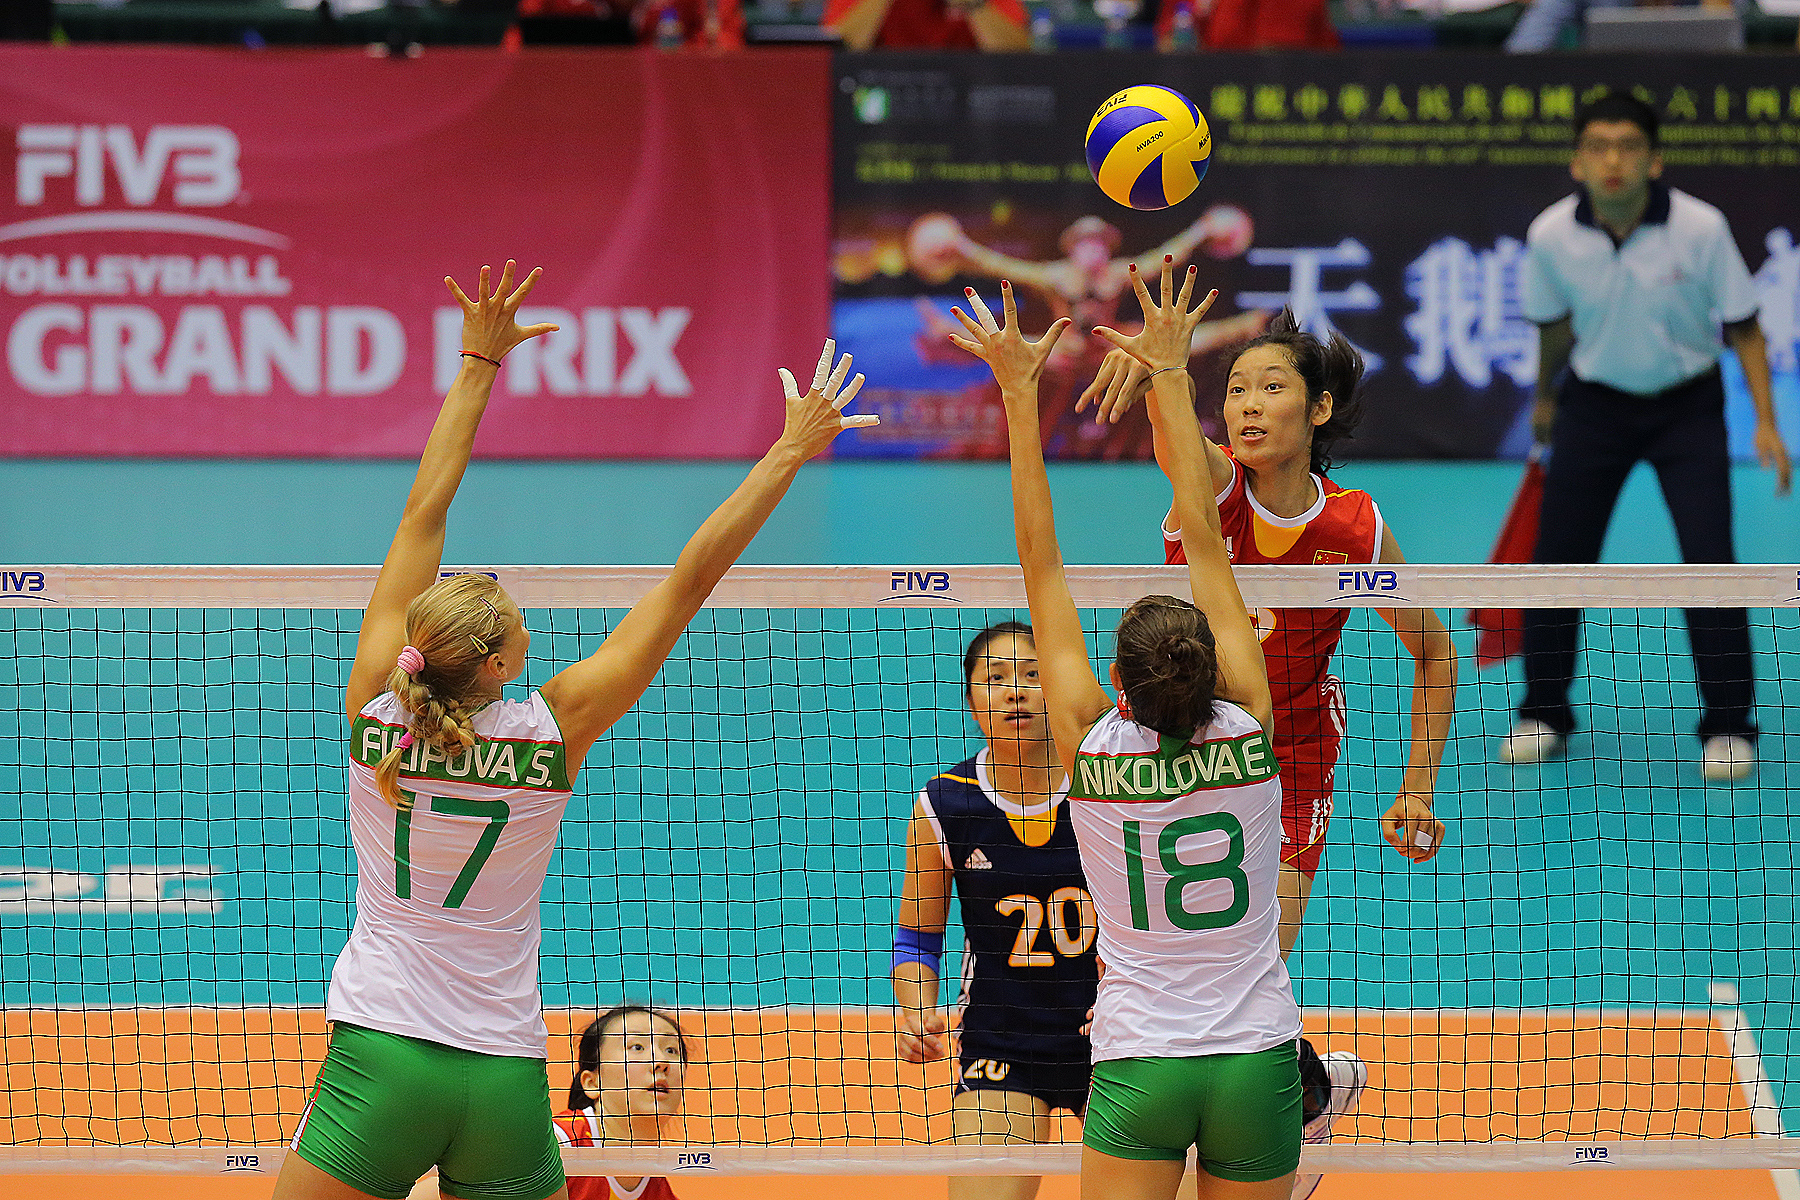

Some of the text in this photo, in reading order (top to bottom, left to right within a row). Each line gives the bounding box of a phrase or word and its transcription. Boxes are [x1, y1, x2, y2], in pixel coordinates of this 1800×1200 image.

[1096, 94, 1128, 118] FIVB
[1136, 130, 1164, 152] MVA200
[17, 124, 242, 206] FIVB
[7, 303, 407, 397] GRAND
[0, 572, 45, 591] IVB
[891, 571, 950, 591] FIVB
[1338, 571, 1398, 591] FIVB
[361, 726, 555, 787] FILIPOVA S.
[1079, 736, 1272, 795] NIKOLOVA E.
[394, 788, 511, 909] 17
[1122, 811, 1250, 931] 18
[995, 886, 1097, 968] 20
[963, 1058, 1011, 1082] 20
[226, 1155, 260, 1167] FIVB
[678, 1153, 712, 1165] FIVB
[1575, 1147, 1609, 1159] FIVB
